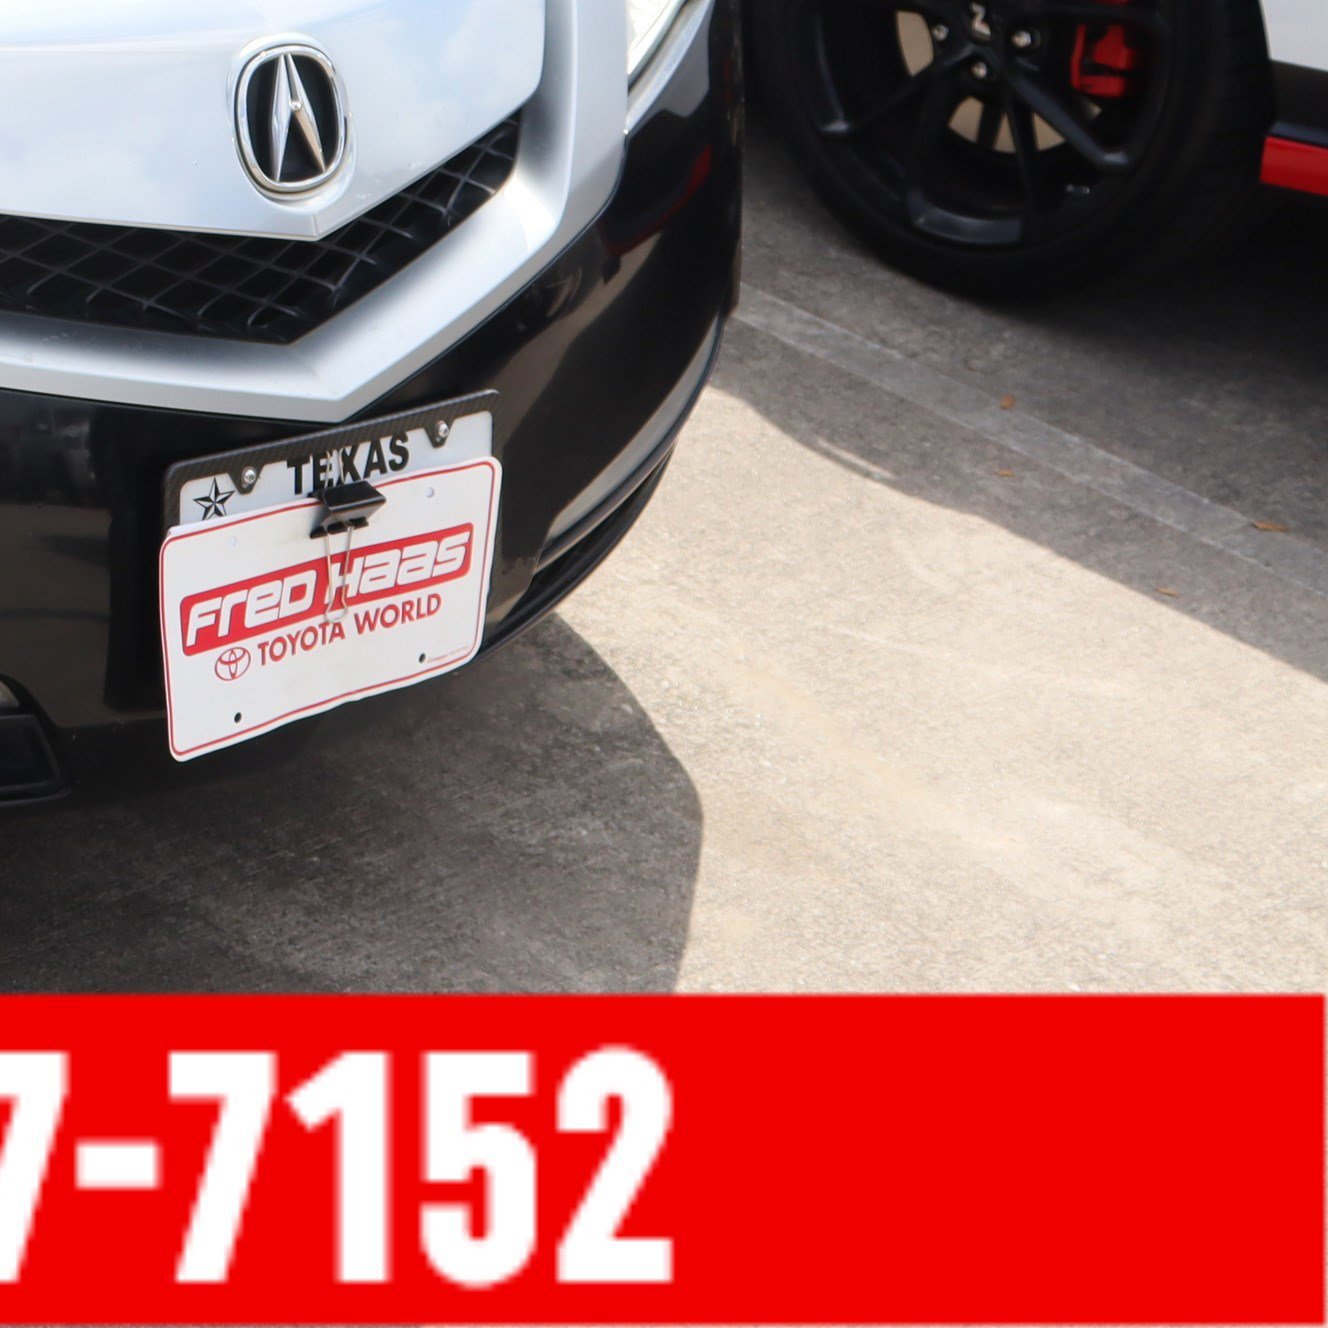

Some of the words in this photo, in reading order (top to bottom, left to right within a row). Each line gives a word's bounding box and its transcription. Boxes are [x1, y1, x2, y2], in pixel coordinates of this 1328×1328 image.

[286, 434, 410, 496] TEXAS
[257, 621, 345, 666] TOYOTA
[354, 592, 442, 636] WORLD
